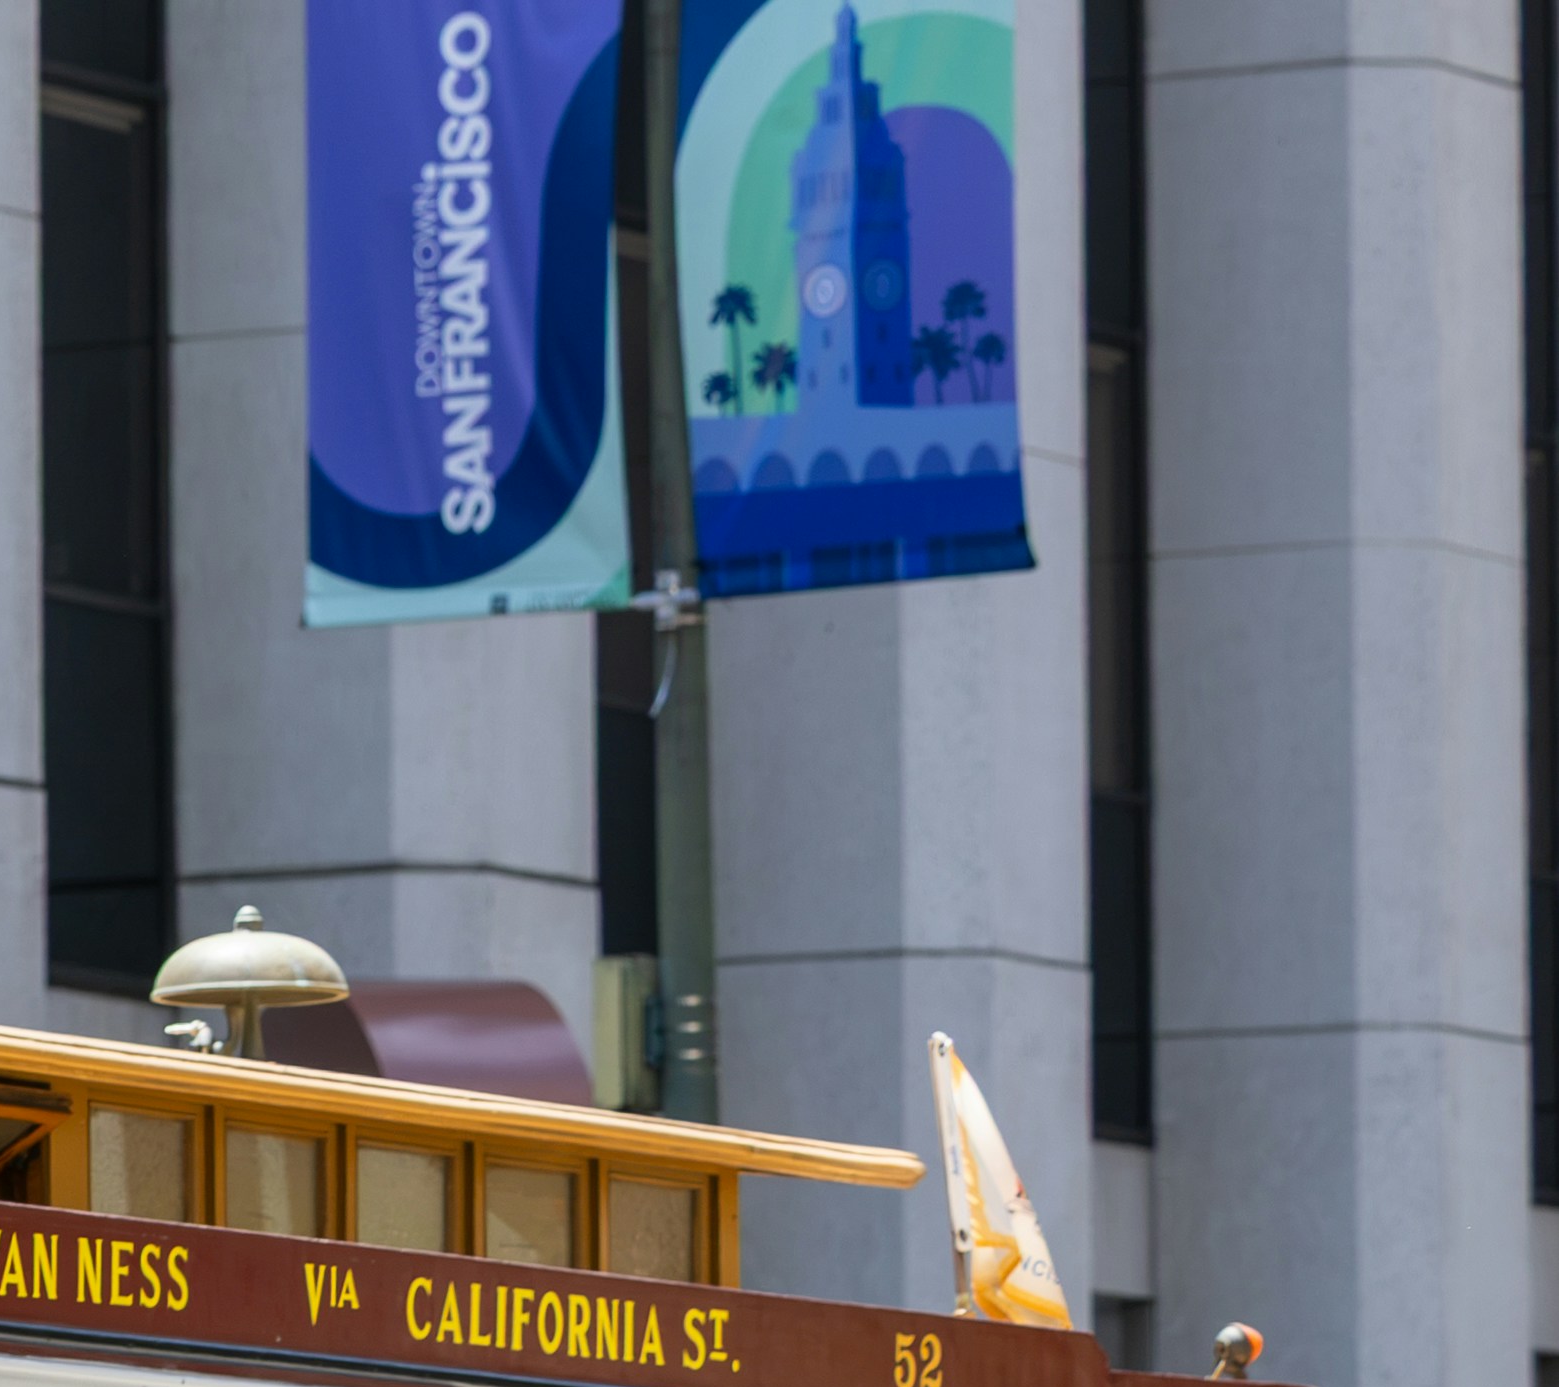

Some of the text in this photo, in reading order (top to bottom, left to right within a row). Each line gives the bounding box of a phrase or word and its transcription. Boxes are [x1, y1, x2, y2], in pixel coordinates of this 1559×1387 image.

[74, 1236, 190, 1313] NESS
[405, 1275, 666, 1369] CALIFORNIA
[680, 1305, 740, 1375] ST.
